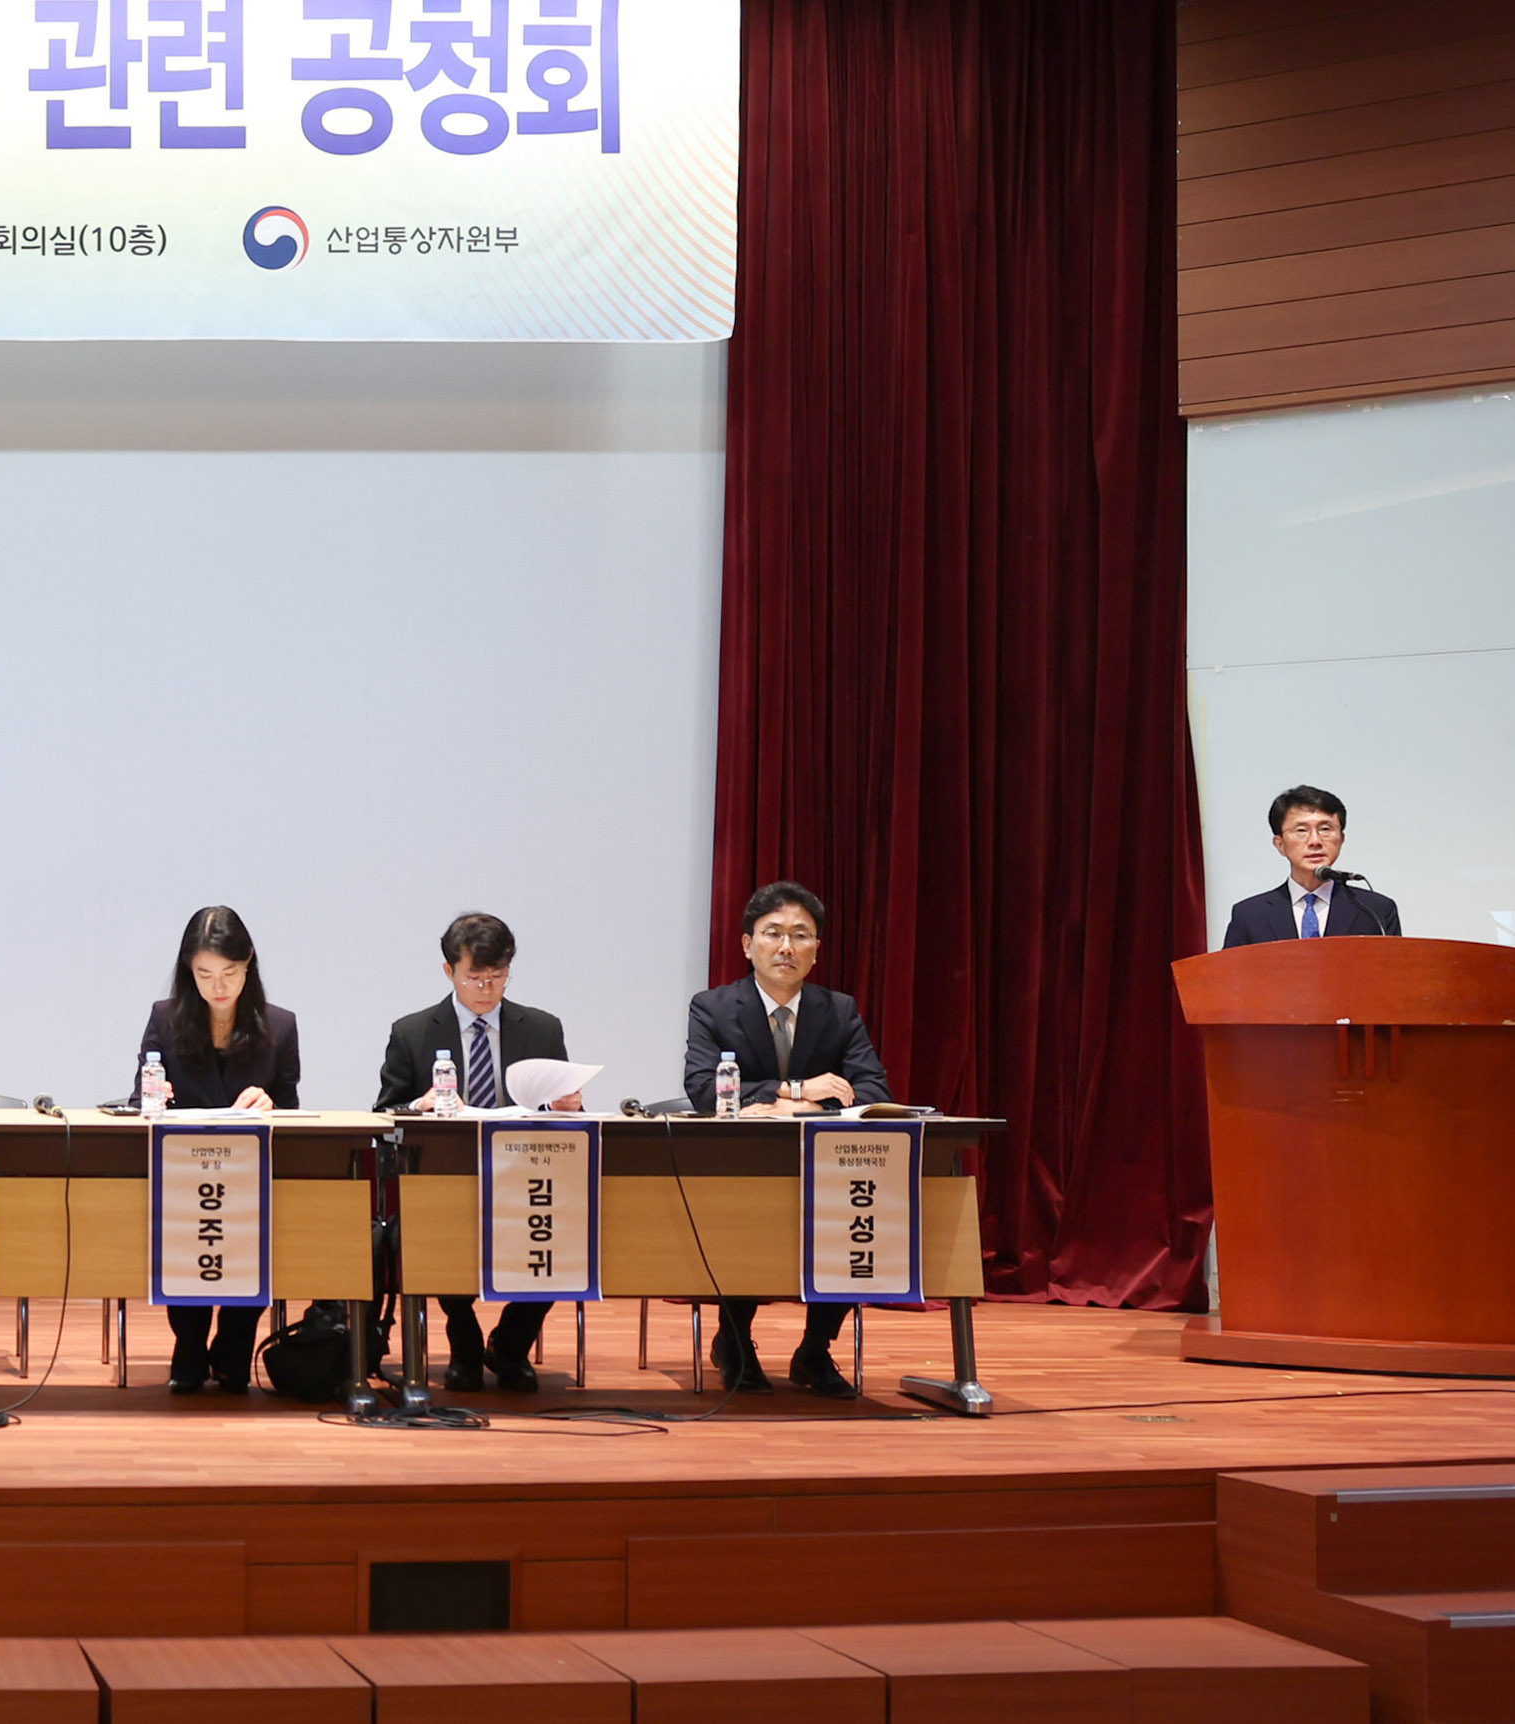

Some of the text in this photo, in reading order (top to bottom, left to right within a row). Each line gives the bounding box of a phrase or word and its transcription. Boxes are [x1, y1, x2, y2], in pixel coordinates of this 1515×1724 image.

[28, 0, 247, 151] 관련
[291, 0, 621, 156] 공청회
[327, 226, 519, 255] 산업통상자원부
[190, 1146, 232, 1158] 산업연구원
[504, 1142, 577, 1154] 대외경제정책연구원
[833, 1143, 891, 1155] 산업통상자원부
[838, 1156, 887, 1168] 통상정책국장
[197, 1182, 226, 1283] 양주영
[526, 1177, 554, 1278] 김영귀
[848, 1179, 876, 1280] 장성길
